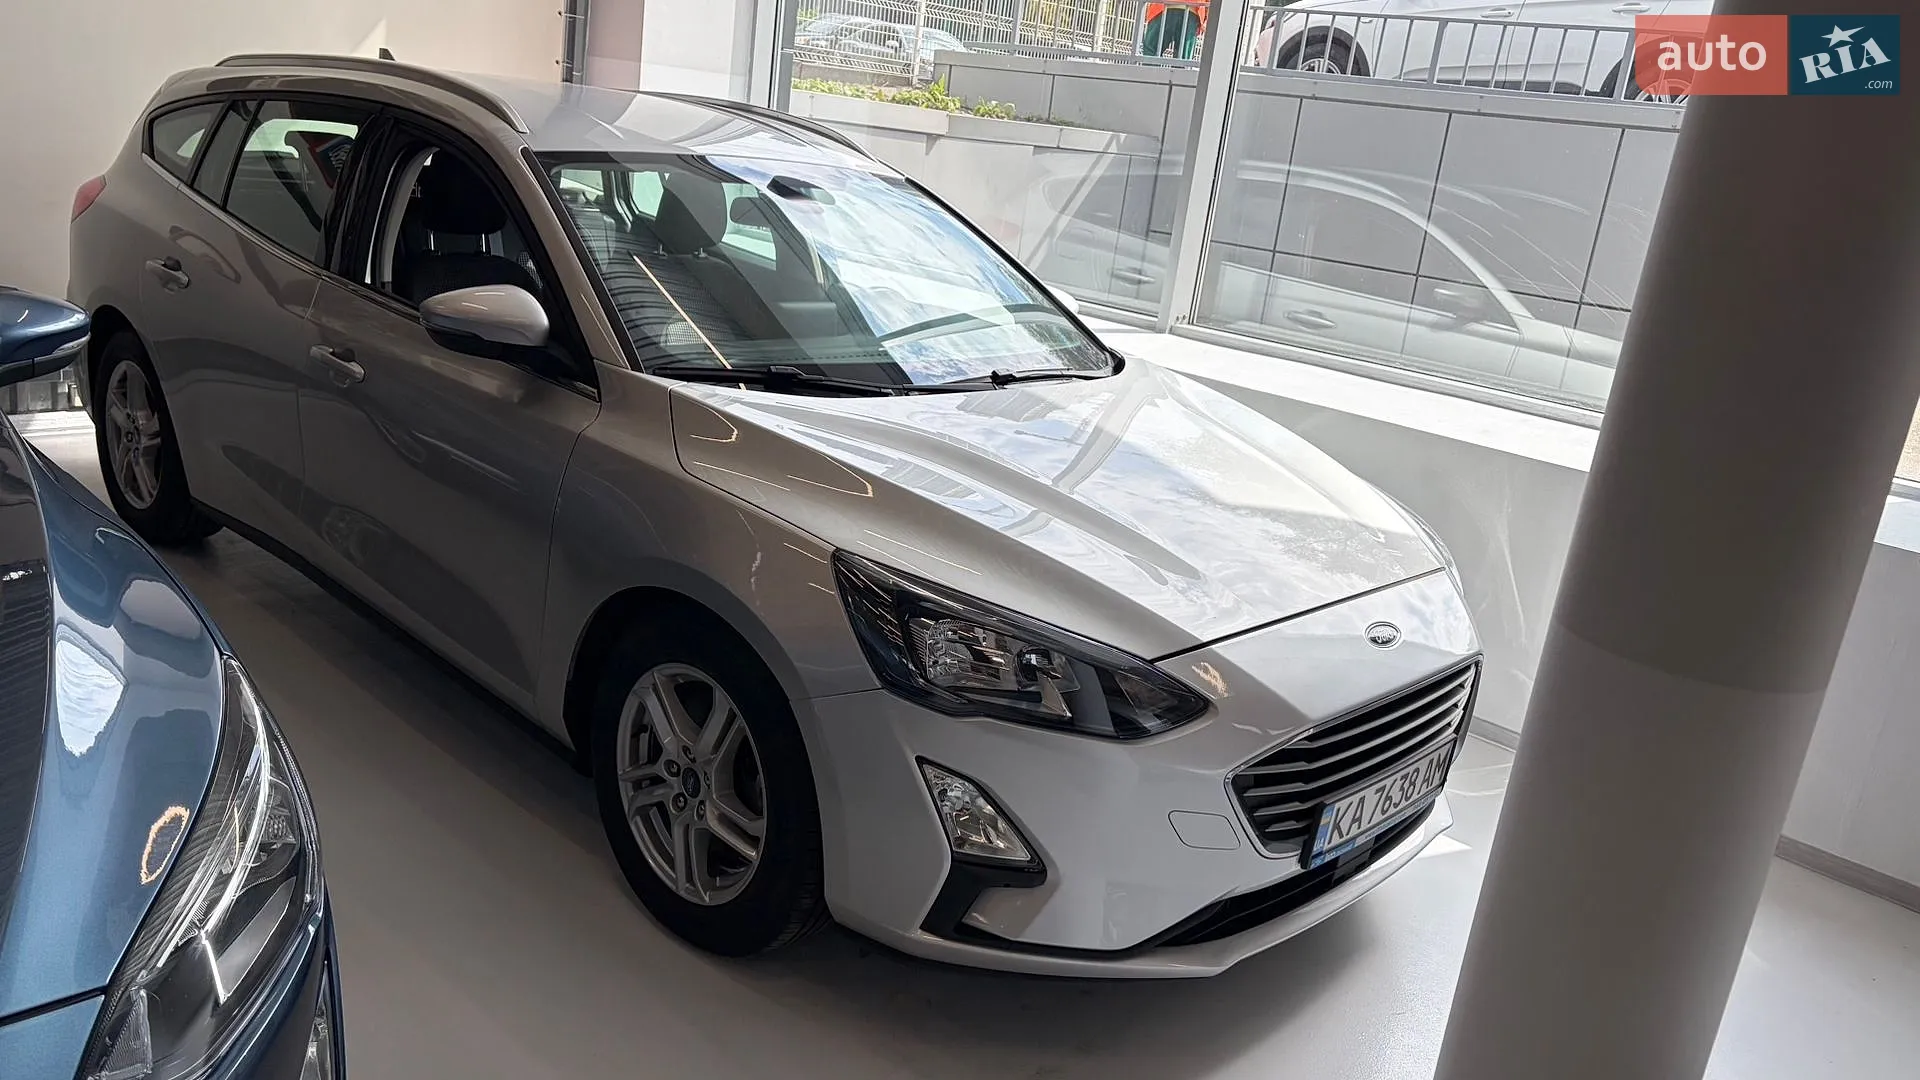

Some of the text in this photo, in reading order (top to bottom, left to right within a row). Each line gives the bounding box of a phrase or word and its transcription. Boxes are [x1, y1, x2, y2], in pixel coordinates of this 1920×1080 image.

[1327, 795, 1366, 845] KA
[1367, 767, 1420, 825] 7638
[1417, 748, 1450, 796] AM
